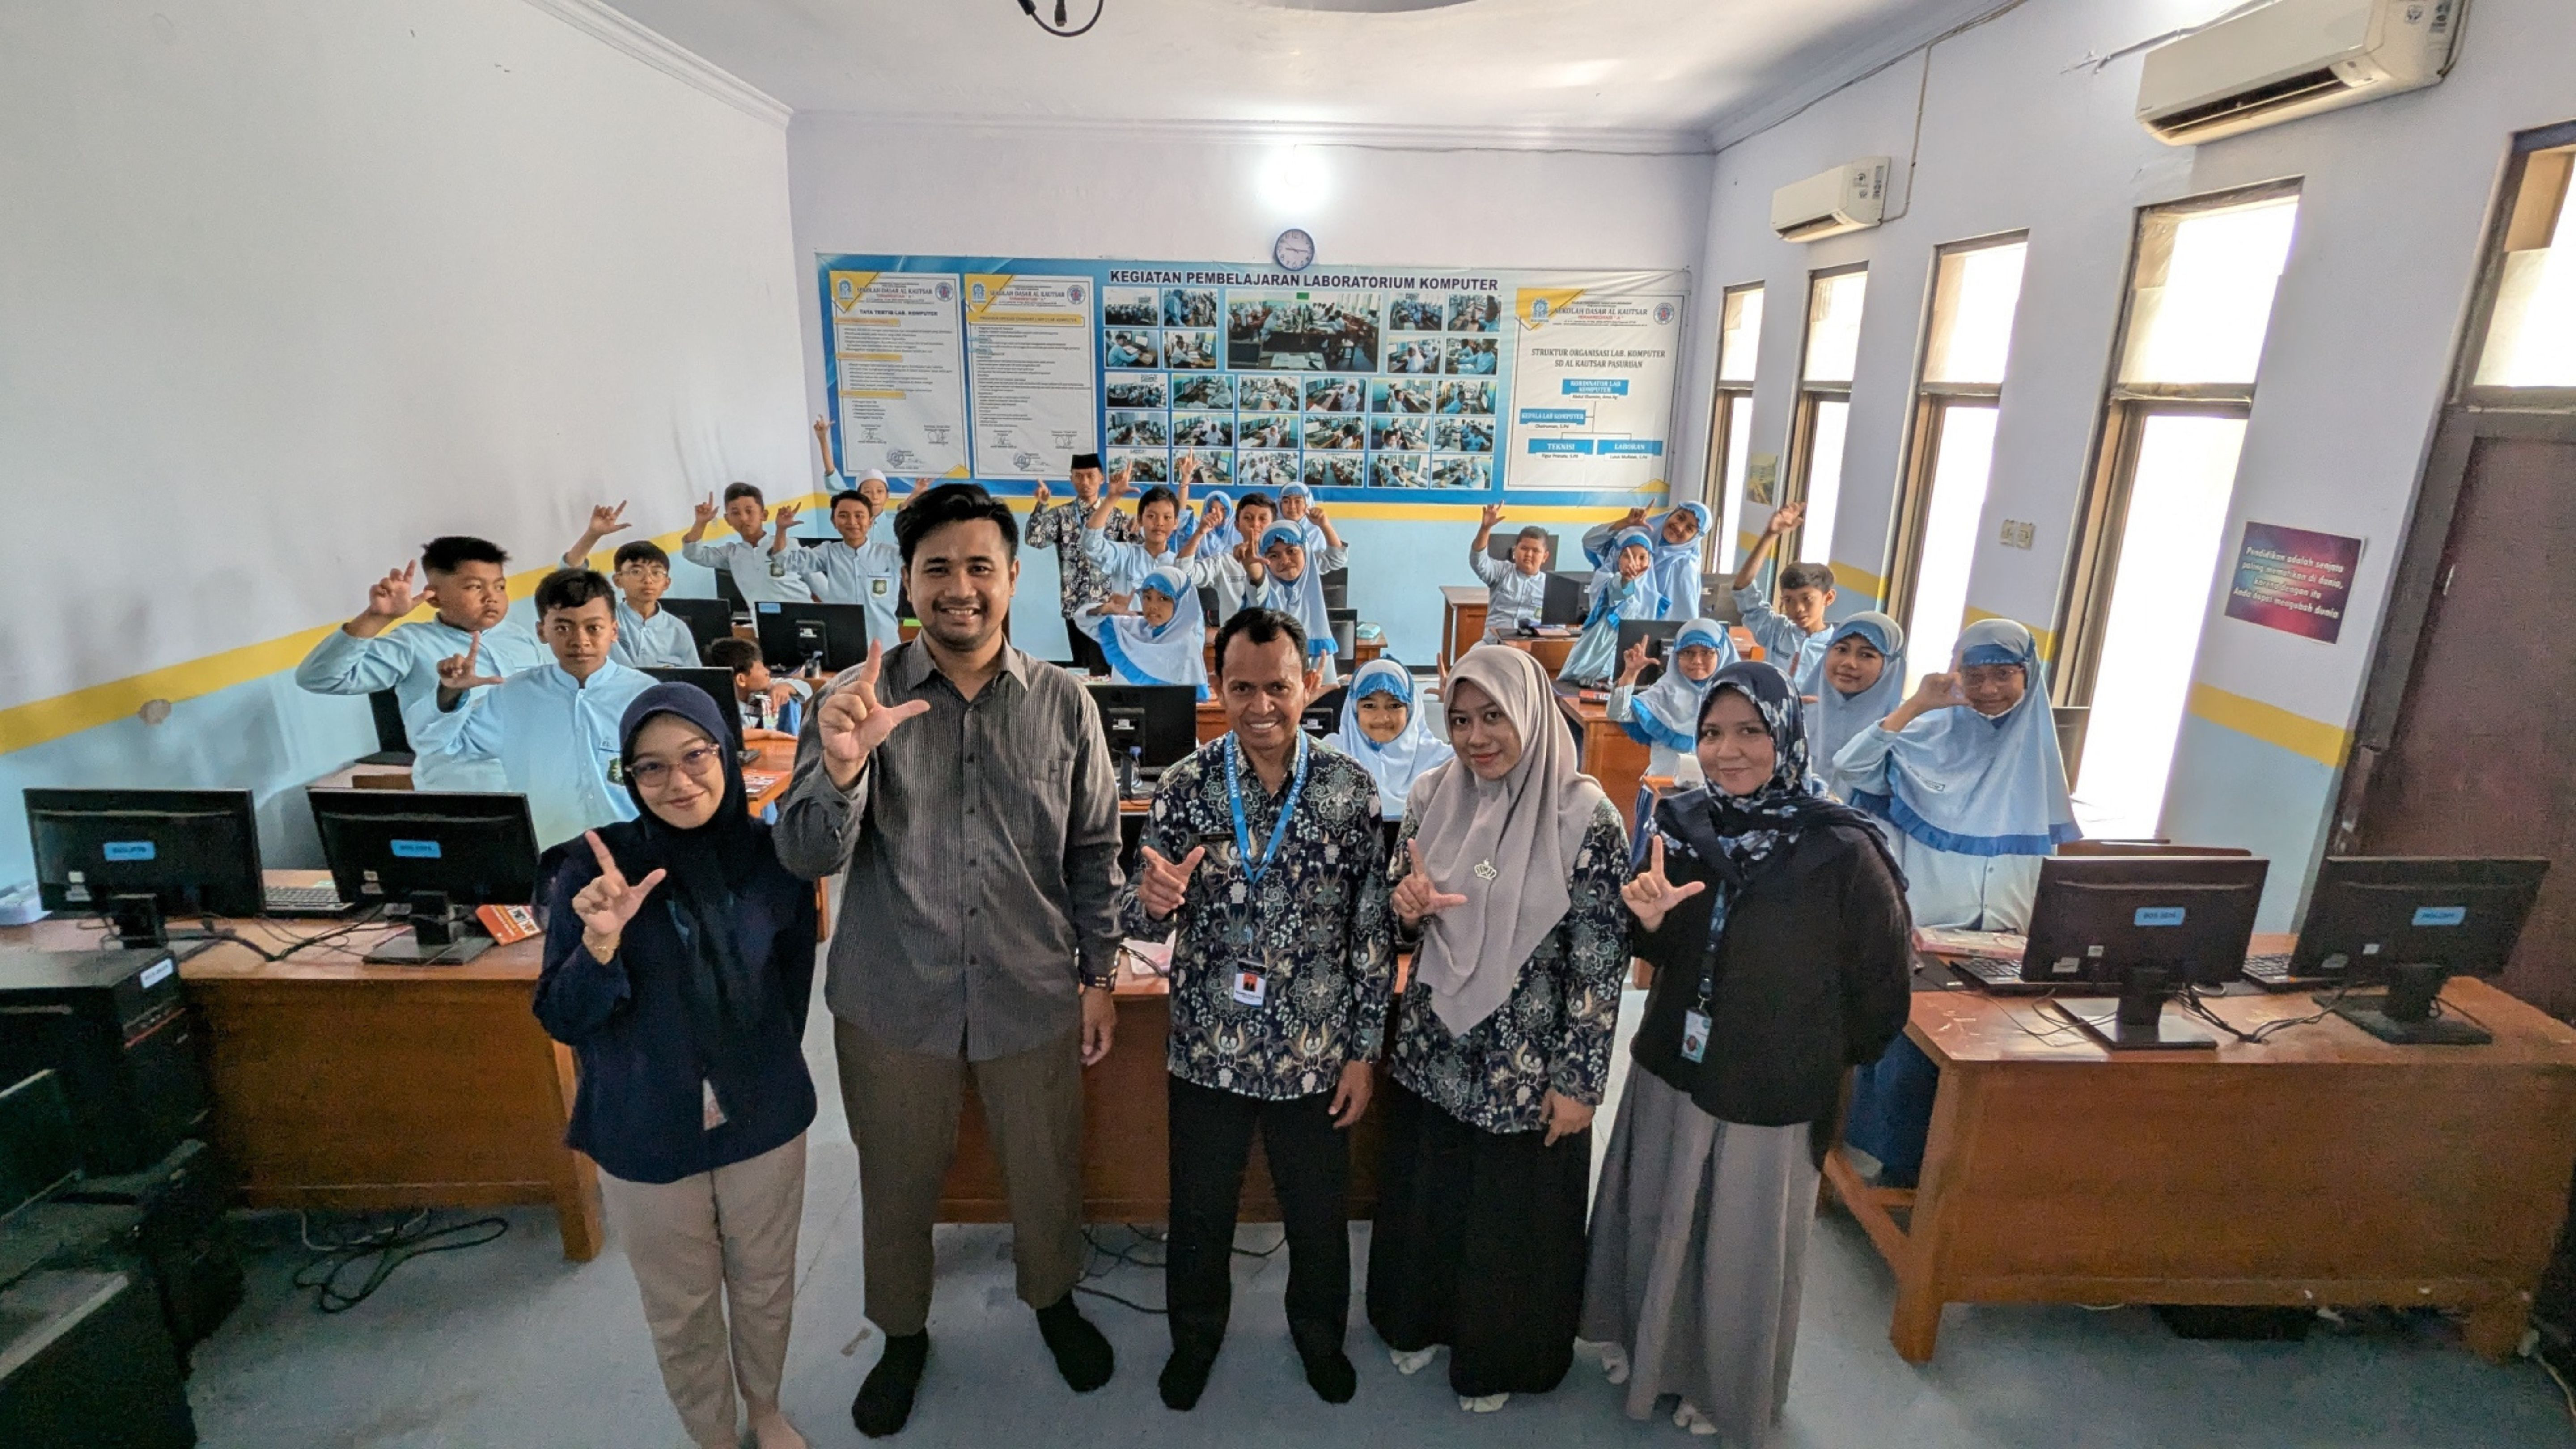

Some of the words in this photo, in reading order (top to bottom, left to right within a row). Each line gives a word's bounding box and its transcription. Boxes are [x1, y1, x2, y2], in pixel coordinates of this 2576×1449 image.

[1110, 271, 1181, 284] KEGIATAN
[1187, 271, 1300, 286] PEMBELAJARAN
[1303, 275, 1415, 289] LABORATORIUM
[1419, 277, 1498, 291] KOMPUTER
[1569, 349, 1609, 357] ORGANISASI
[2246, 547, 2285, 561] Pendidikan
[2287, 555, 2313, 567] adalah
[2242, 562, 2263, 572] paling
[2308, 574, 2316, 583] di
[2281, 581, 2308, 596] dengan
[2233, 586, 2252, 597] Anda
[2314, 605, 2339, 619] dunia
[1226, 745, 1233, 754] SD
[1228, 757, 1233, 765] AL
[1228, 766, 1238, 798] KAUTSAR
[1288, 795, 1295, 805] SD
[1292, 785, 1300, 794] AL
